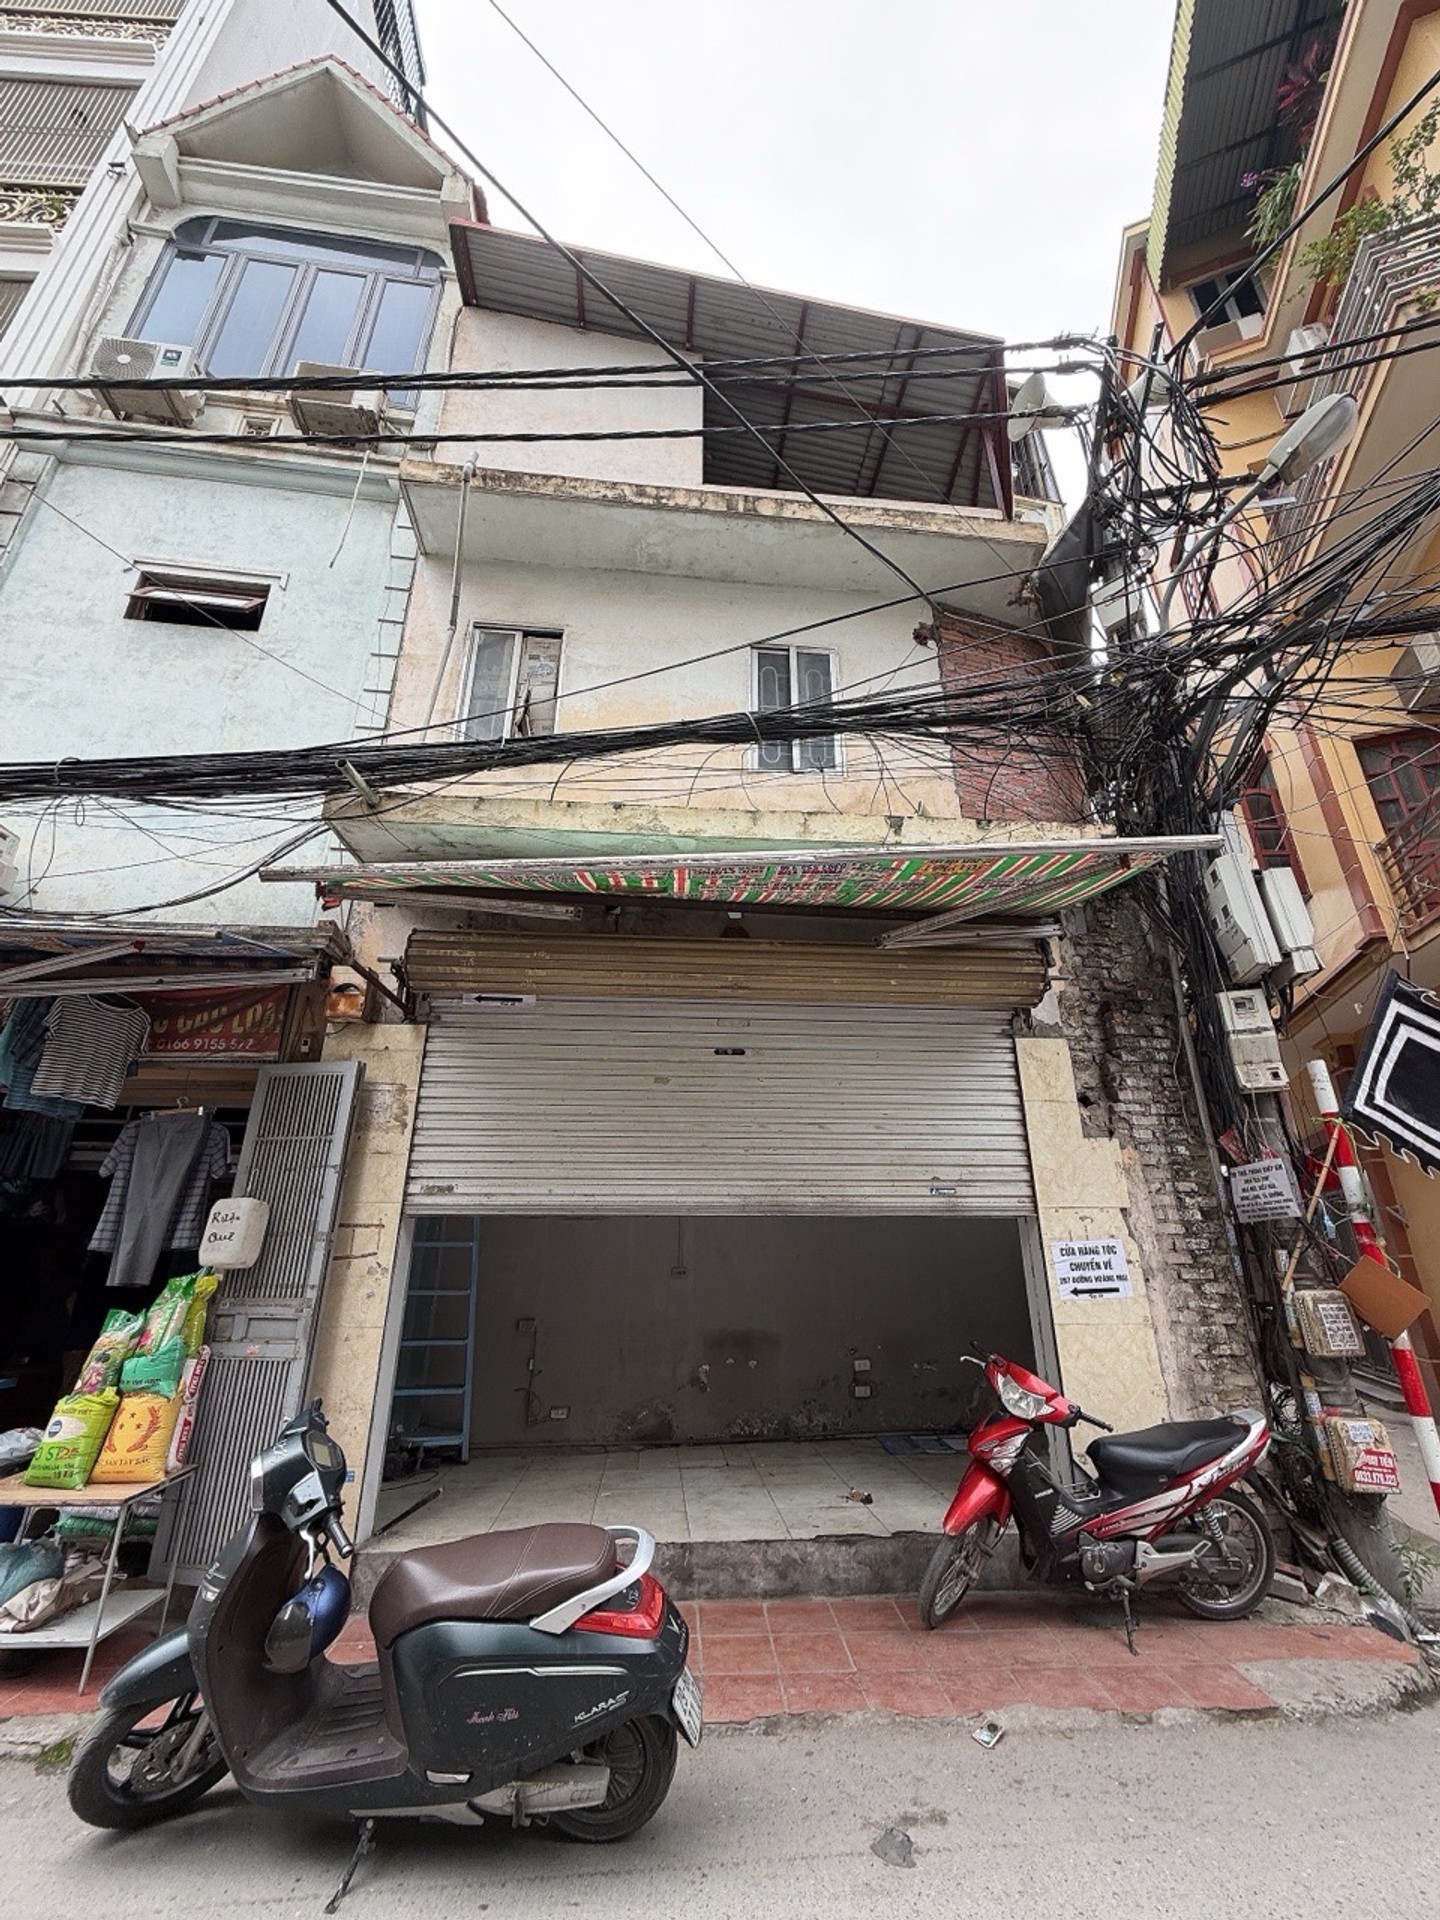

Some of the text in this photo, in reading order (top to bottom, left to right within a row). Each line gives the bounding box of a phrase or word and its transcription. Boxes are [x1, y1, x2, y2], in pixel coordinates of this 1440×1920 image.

[1059, 1243, 1117, 1257] CỬA HÀNG TÓC
[1069, 1257, 1102, 1272] CHUYỂN
[574, 1697, 616, 1722] KLARA
